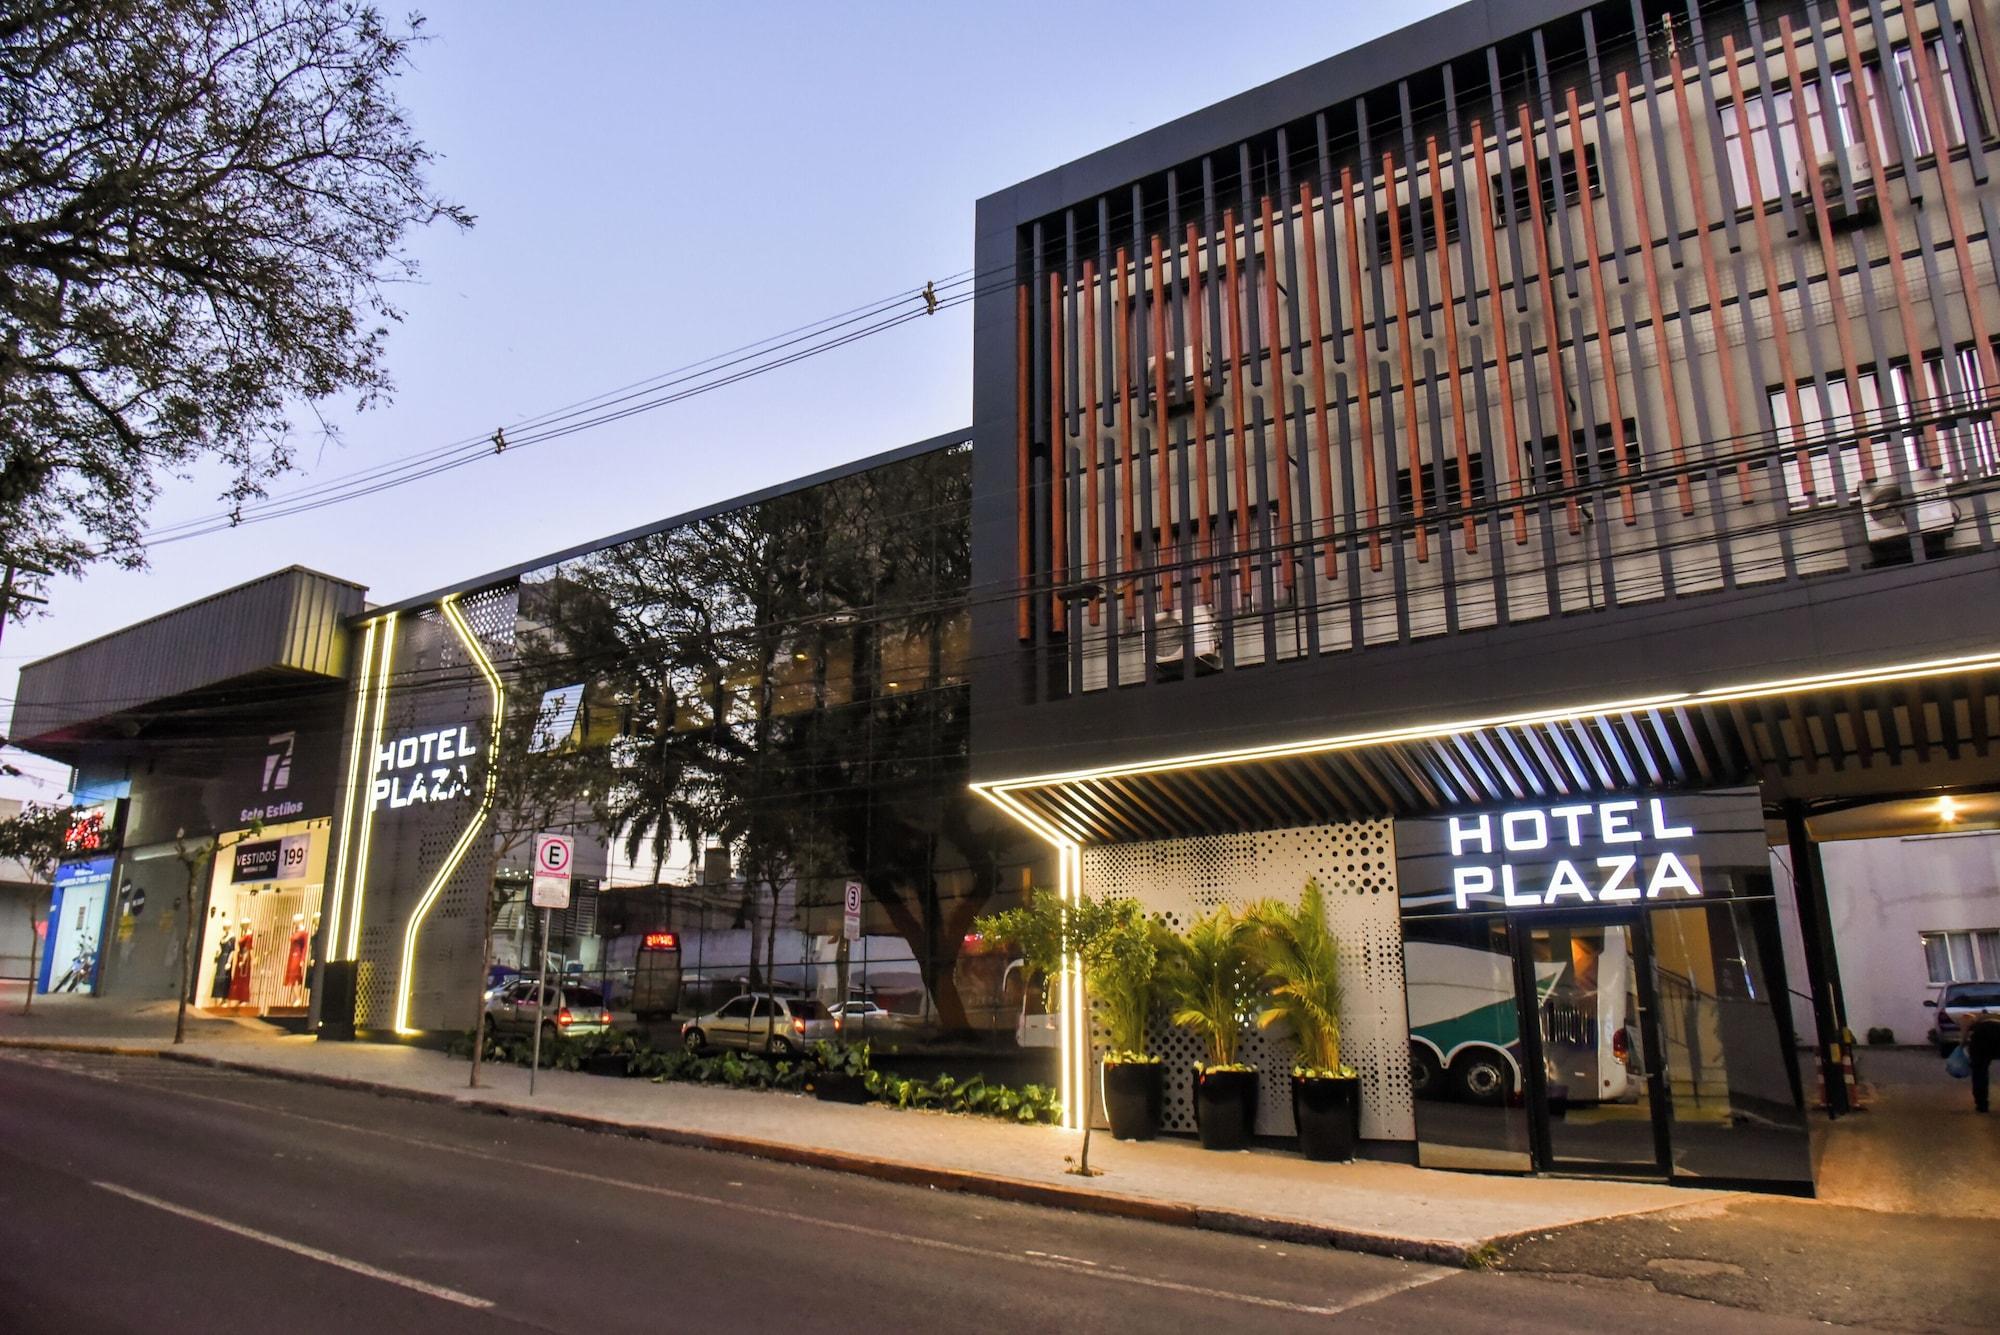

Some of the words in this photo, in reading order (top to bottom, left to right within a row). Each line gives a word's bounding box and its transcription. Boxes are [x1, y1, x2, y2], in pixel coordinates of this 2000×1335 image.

[377, 727, 476, 772] HOTEL
[371, 765, 471, 811] PLAZA
[266, 801, 304, 819] Estilos
[1449, 799, 1694, 856] HOTEL
[236, 850, 277, 867] VESTIDOS
[283, 847, 304, 866] 199
[549, 845, 561, 865] E
[1454, 852, 1702, 909] PLAZA
